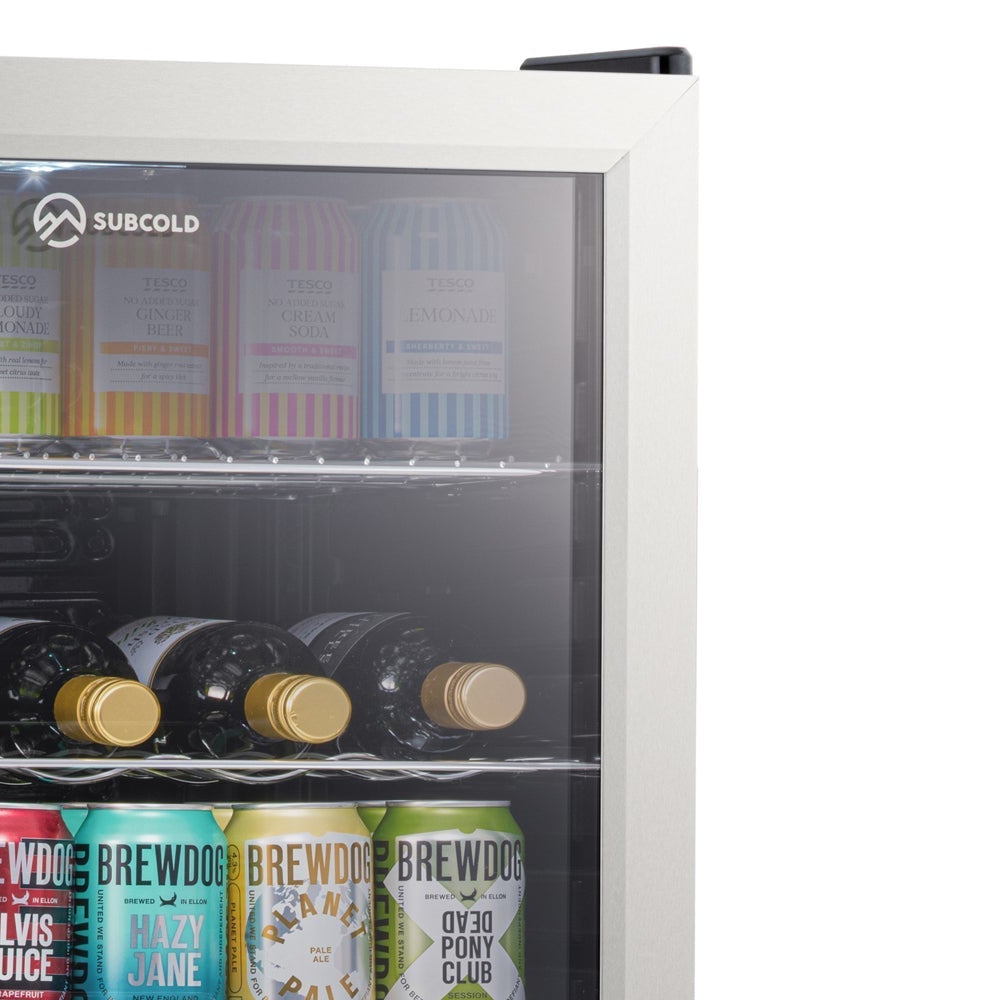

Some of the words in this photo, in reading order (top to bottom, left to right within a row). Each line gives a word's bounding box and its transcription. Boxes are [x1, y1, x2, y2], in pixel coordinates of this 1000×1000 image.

[93, 212, 199, 233] SUBCOLD
[142, 277, 188, 289] TESCO
[286, 279, 333, 290] TESCO
[427, 278, 475, 289] TESCO
[135, 308, 192, 322] GINGER
[281, 310, 337, 324] CREAM
[147, 323, 184, 337] BEER
[288, 325, 329, 339] SODA
[97, 843, 223, 888] BREWDOG
[248, 841, 370, 887] BREWDOG
[397, 839, 521, 882] BREWDOG
[261, 890, 367, 945] PLANET
[441, 910, 493, 934] DEAD
[129, 913, 204, 950] HAZY
[310, 946, 332, 954] PALE
[441, 935, 494, 959] PONY
[312, 955, 329, 963] ALE
[127, 951, 202, 987] JANE
[442, 960, 493, 984] CLUB
[448, 991, 488, 999] SESSION
